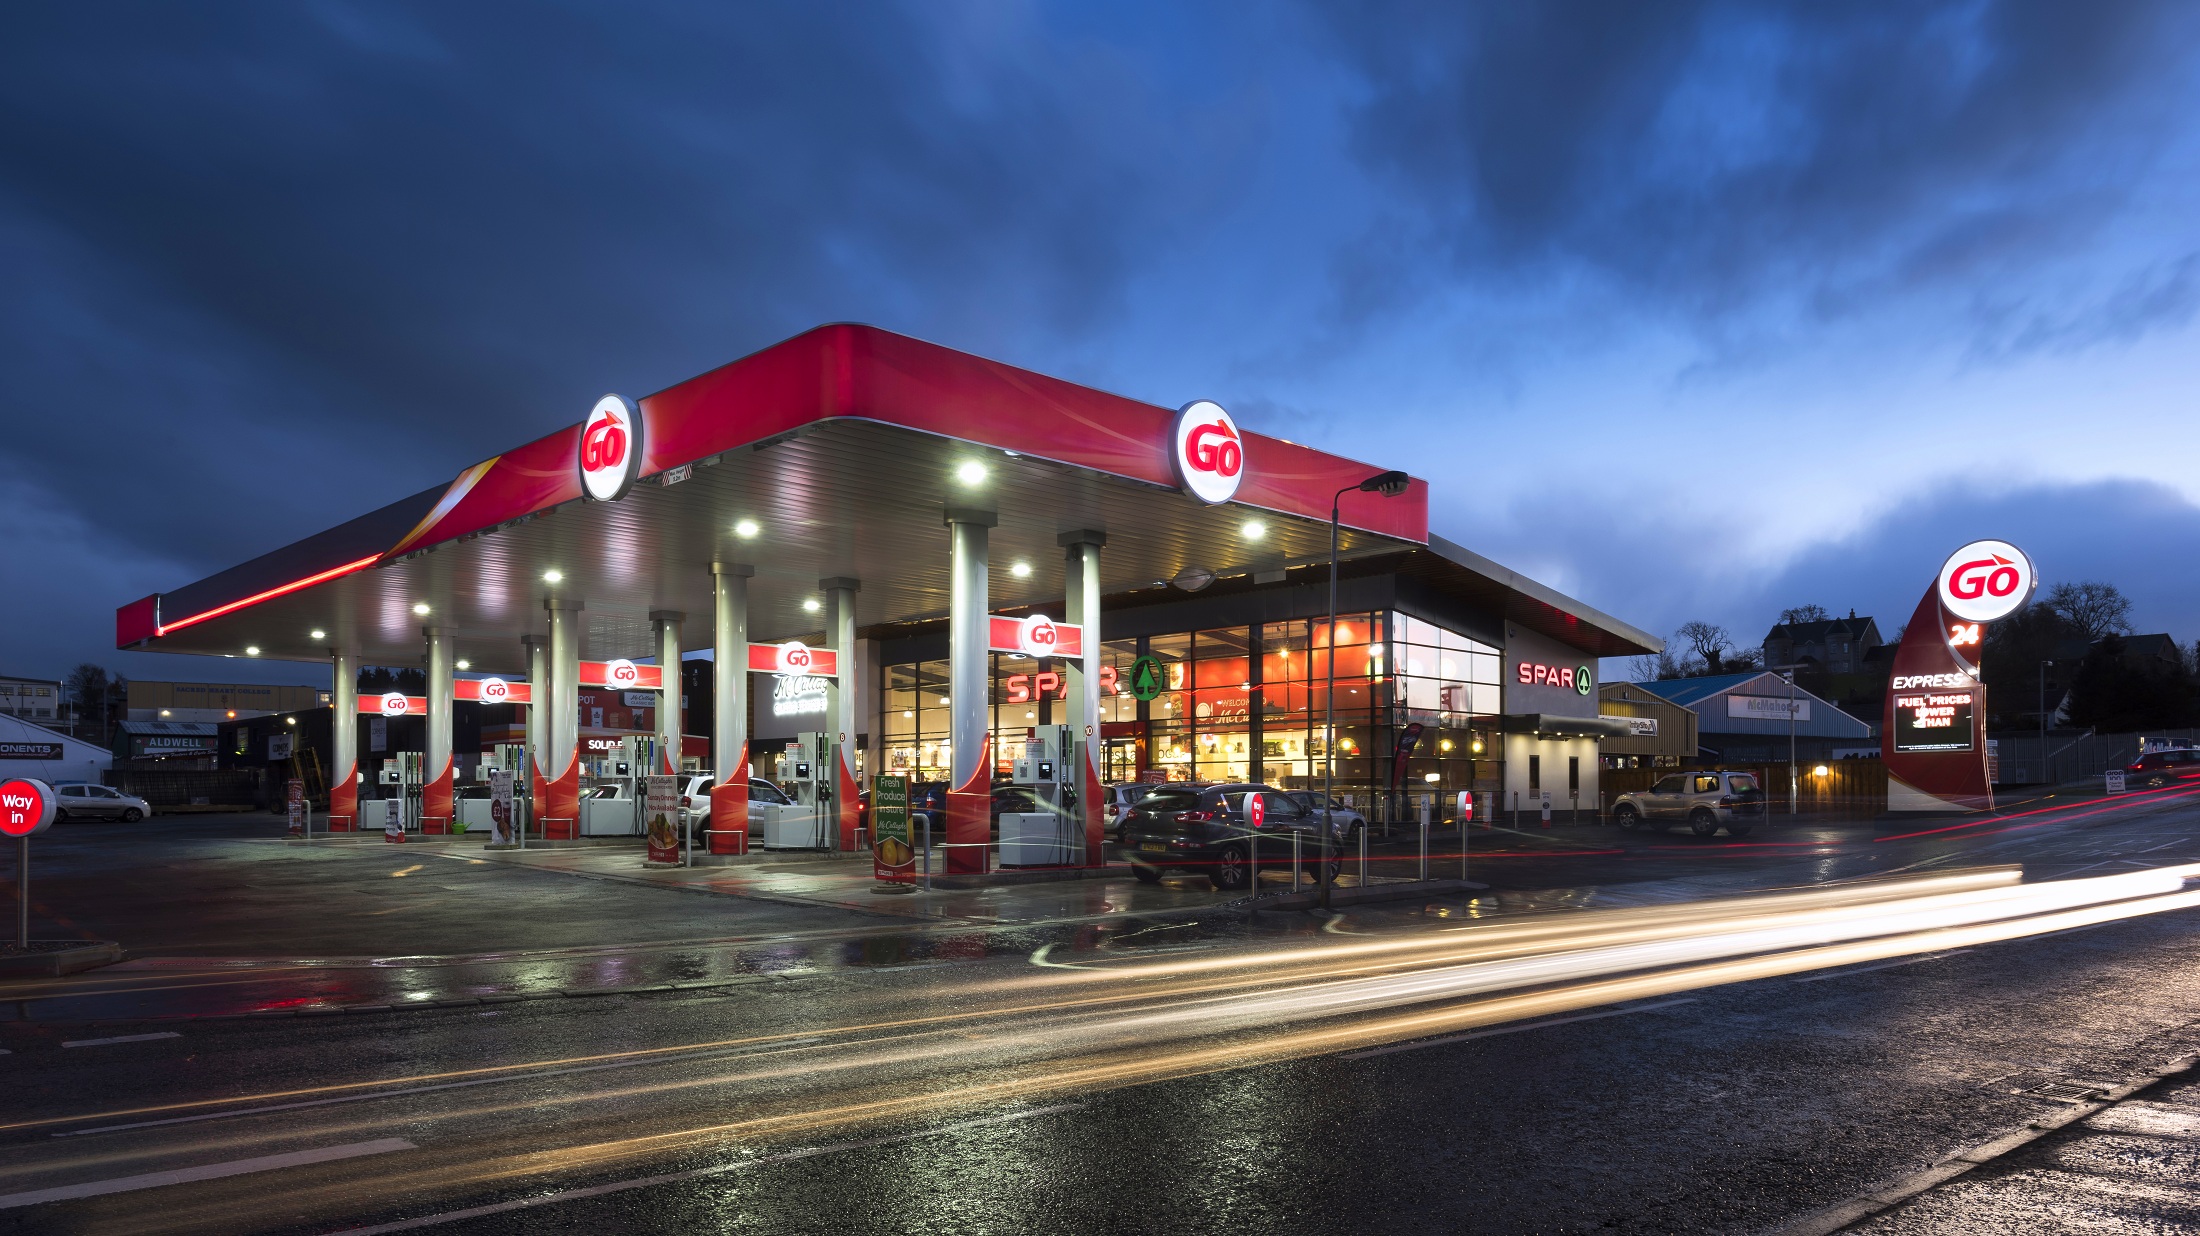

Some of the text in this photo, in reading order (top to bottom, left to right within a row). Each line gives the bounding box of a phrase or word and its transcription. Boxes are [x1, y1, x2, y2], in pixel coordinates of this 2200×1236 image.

[581, 411, 627, 473] Go
[1185, 419, 1242, 478] Go
[1949, 554, 2020, 600] Go
[1030, 623, 1056, 645] Go
[1949, 624, 1980, 646] 24
[787, 649, 810, 667] Go
[614, 666, 635, 681] Go
[1519, 662, 1574, 689] SPAR
[1006, 666, 1118, 703] SPR
[1892, 673, 1965, 690] EXPRESS
[486, 683, 506, 696] Go
[387, 698, 406, 710] Go
[578, 695, 600, 705] POT
[1898, 695, 1973, 708] FUEL PRICES
[1915, 707, 1955, 718] LOWER
[1086, 726, 1093, 735] 10
[0, 744, 51, 753] ONENTS
[880, 777, 900, 788] Fresh
[2, 794, 34, 811] Way
[877, 790, 906, 802] Produce
[1253, 801, 1262, 812] Way
[11, 810, 24, 824] in
[1255, 811, 1260, 820] in
